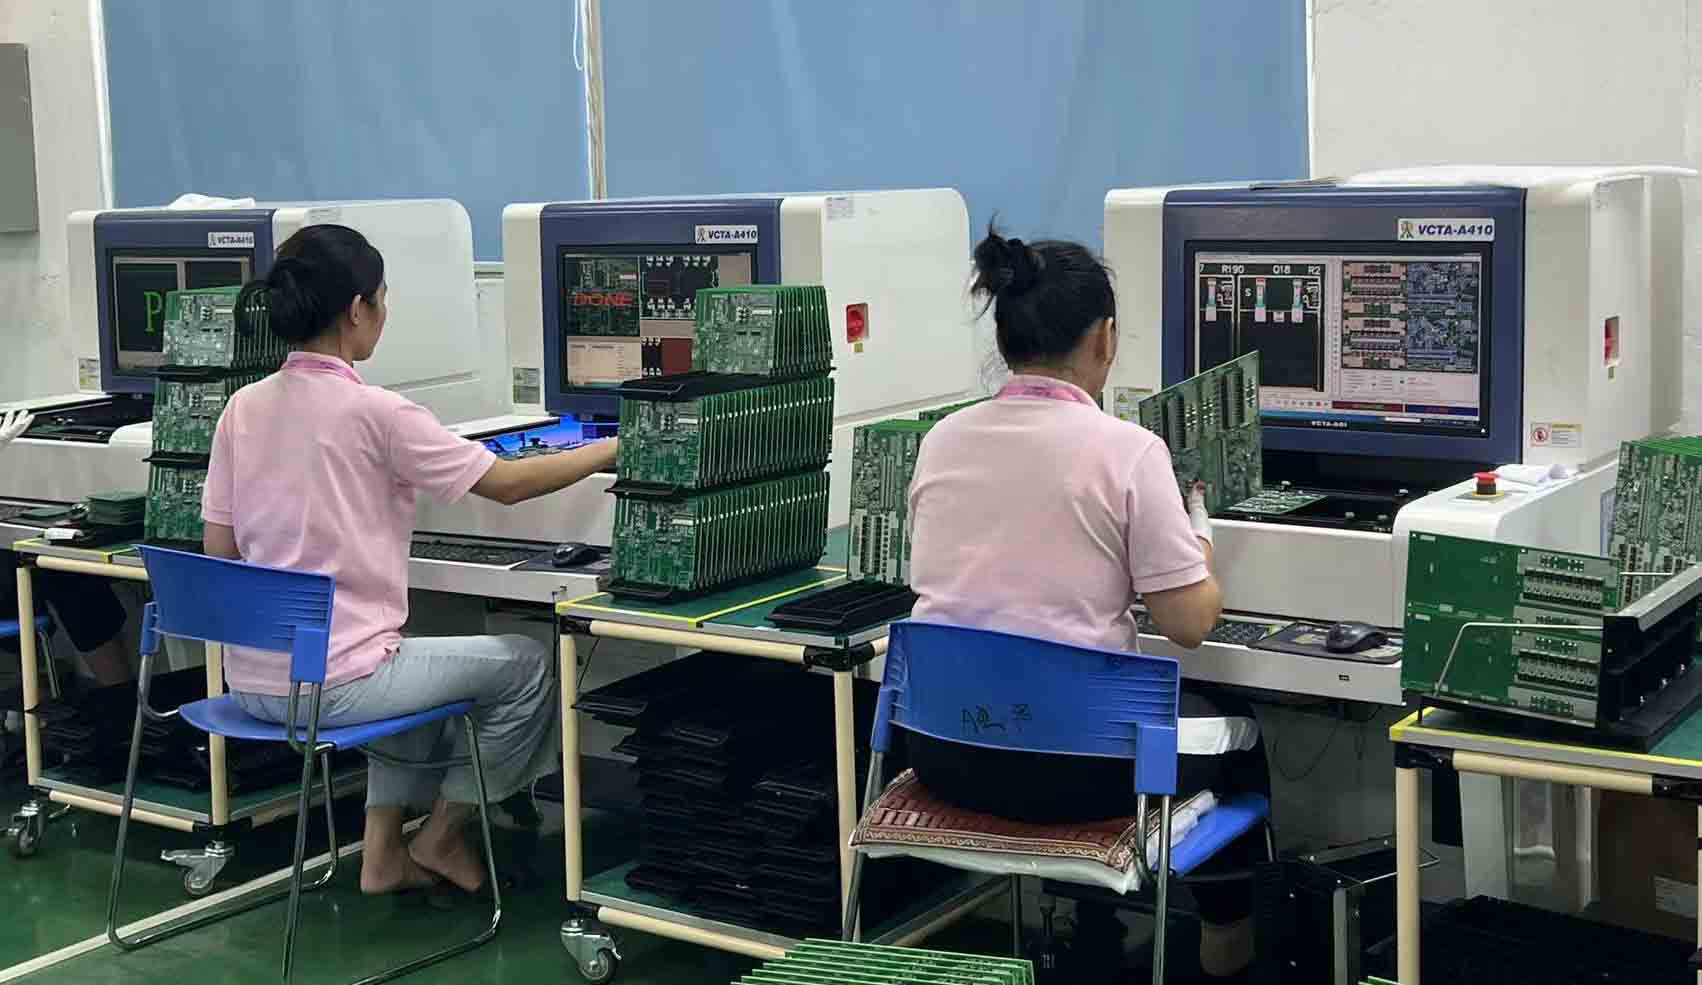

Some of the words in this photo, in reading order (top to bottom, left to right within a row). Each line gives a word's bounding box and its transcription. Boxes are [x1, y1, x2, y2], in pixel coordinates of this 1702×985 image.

[708, 230, 757, 239] VCTA-A410
[1418, 224, 1493, 235] VCTA-A410
[1221, 264, 1245, 274] R190
